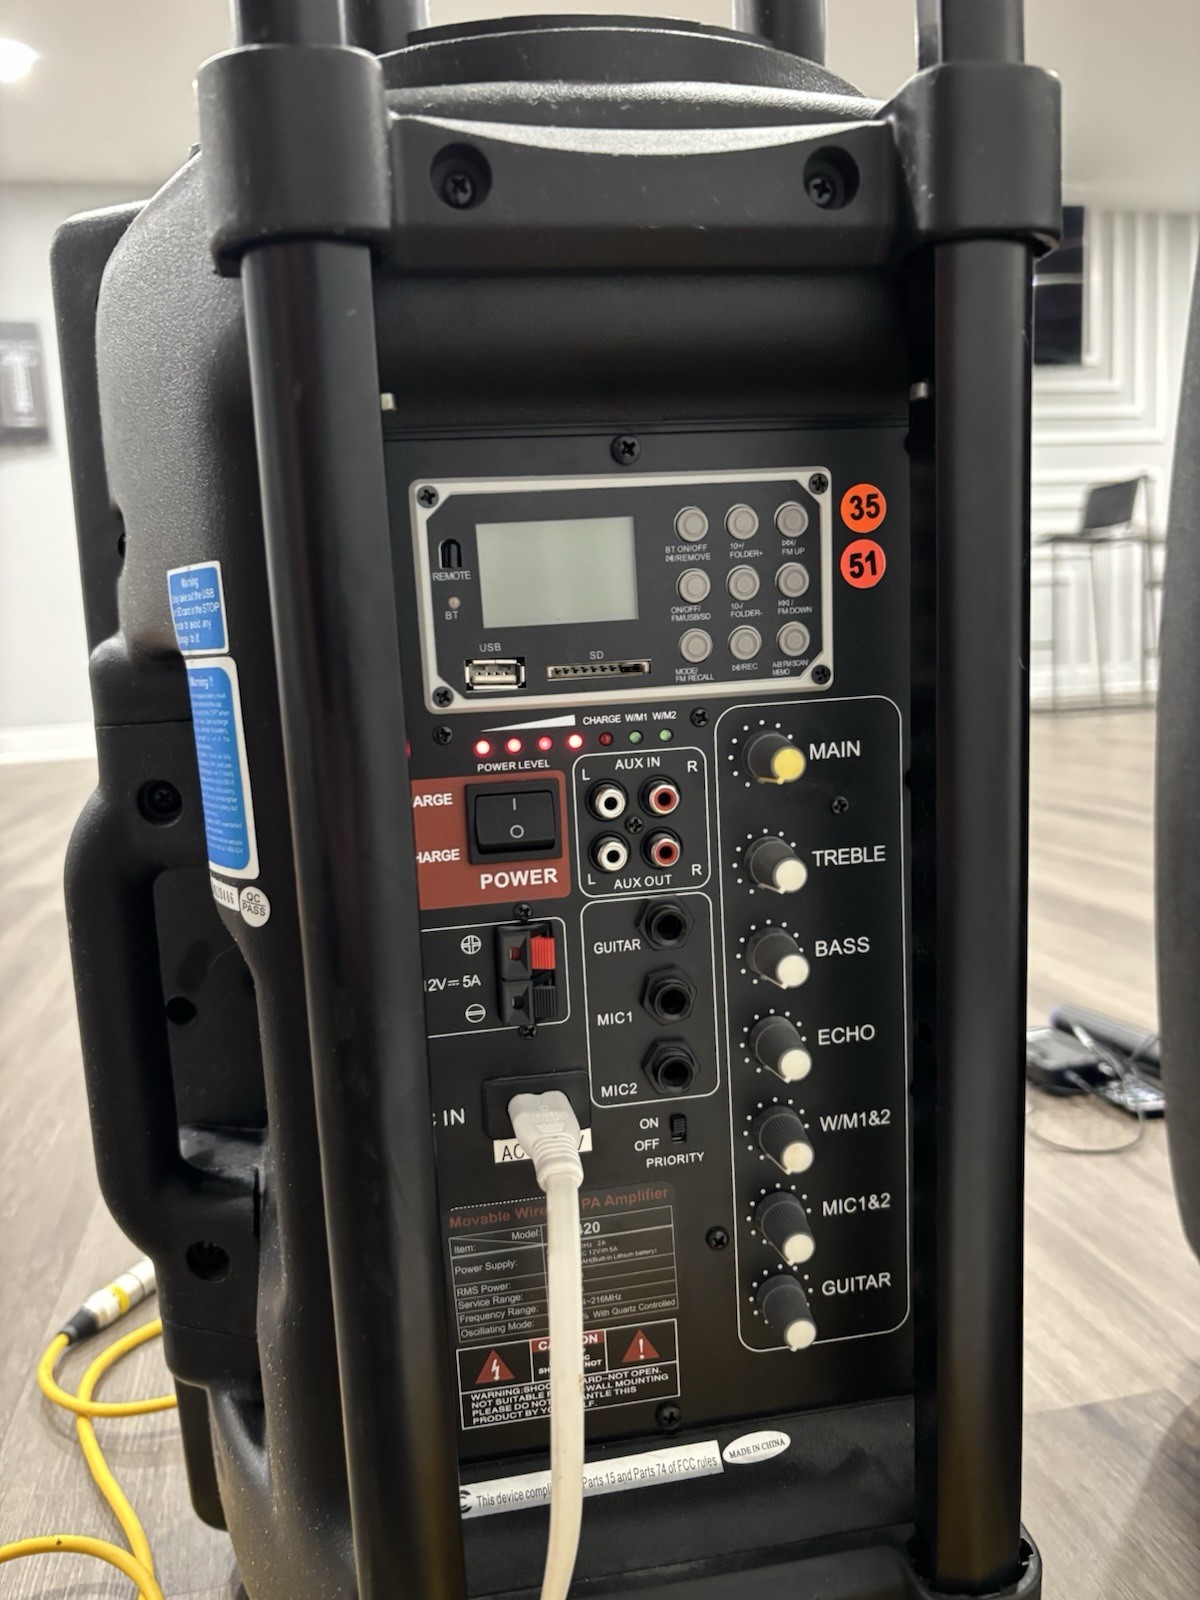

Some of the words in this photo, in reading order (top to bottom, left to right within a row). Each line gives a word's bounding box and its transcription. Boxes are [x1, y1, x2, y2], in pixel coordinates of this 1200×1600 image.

[850, 493, 880, 521] 35
[665, 545, 676, 554] BT
[677, 544, 708, 553] ON/OFF
[794, 547, 806, 555] UP
[849, 550, 877, 579] 51
[432, 571, 471, 581] REMOTE
[202, 602, 220, 614] STOP
[445, 611, 459, 620] BT
[777, 607, 789, 615] FM
[789, 605, 813, 614] DOWN
[479, 643, 502, 652] USB
[589, 651, 604, 660] SD
[688, 673, 715, 682] RECALL
[583, 714, 621, 726] CHARGE
[625, 712, 648, 723] W/M1
[652, 711, 677, 721] W/M2
[809, 740, 861, 761] MAIN
[477, 761, 516, 772] POWER
[518, 758, 550, 770] LEVEL
[615, 757, 643, 770] AUX
[647, 756, 661, 768] IN
[687, 761, 698, 772] R
[582, 768, 590, 780] L
[413, 793, 453, 808] ARGE
[811, 845, 886, 867] TREBLE
[692, 863, 702, 876] R
[480, 867, 558, 890] POWER
[587, 873, 596, 885] L
[613, 876, 641, 890] AUX
[644, 874, 672, 887] OUT
[246, 891, 261, 903] QC
[242, 902, 266, 917] PASS
[593, 938, 641, 955] GUITAR
[814, 936, 870, 958] BASS
[462, 974, 482, 988] 5A
[597, 1011, 633, 1026] MIC1
[817, 1024, 876, 1046] ECHO
[600, 1082, 638, 1098] MIC2
[443, 1107, 466, 1126] IN
[639, 1117, 660, 1130] ON
[820, 1108, 891, 1132] W/M1&2
[634, 1138, 660, 1152] OFF
[645, 1151, 705, 1168] PRIORITY
[448, 1209, 511, 1229] Movable
[515, 1206, 548, 1220] Wire
[581, 1196, 601, 1210] PA
[604, 1188, 669, 1208] Amplifier
[822, 1192, 891, 1217] MIC1&2
[511, 1228, 541, 1241] Model:
[454, 1244, 476, 1254] Item:
[454, 1263, 483, 1276] Power
[484, 1259, 518, 1273] Supply:
[456, 1286, 479, 1297] RMS
[481, 1282, 511, 1294] Power:
[821, 1272, 892, 1296] GUITAR
[458, 1298, 491, 1311] Service
[492, 1293, 523, 1306] Range:
[459, 1310, 506, 1324] Frequency
[507, 1305, 539, 1318] Range:
[460, 1324, 506, 1339] Oscillating
[508, 1320, 534, 1331] Mode:
[593, 1308, 611, 1319] With
[611, 1304, 637, 1317] Quartz
[638, 1298, 676, 1312] Controlled
[584, 1359, 602, 1368] NOT
[632, 1366, 662, 1377] OPEN.
[471, 1399, 494, 1409] NOT
[495, 1391, 545, 1406] SUITABLE
[615, 1373, 669, 1388] MOUNTING
[472, 1404, 512, 1417] PLEASE
[514, 1402, 530, 1411] DO
[613, 1385, 638, 1396] THIS
[472, 1410, 524, 1425] PRODUCT
[525, 1408, 539, 1417] BY
[729, 1446, 752, 1459] MADE
[752, 1444, 761, 1453] IN
[761, 1438, 786, 1451] CHINA
[476, 1495, 495, 1508] This
[497, 1489, 524, 1504] device
[582, 1475, 603, 1489] Parts
[605, 1471, 616, 1484] 15
[617, 1469, 632, 1483] and
[633, 1467, 655, 1480] Parts
[656, 1463, 667, 1476] 74
[668, 1461, 678, 1474] of
[678, 1457, 696, 1472] FCC
[697, 1455, 718, 1469] rules
